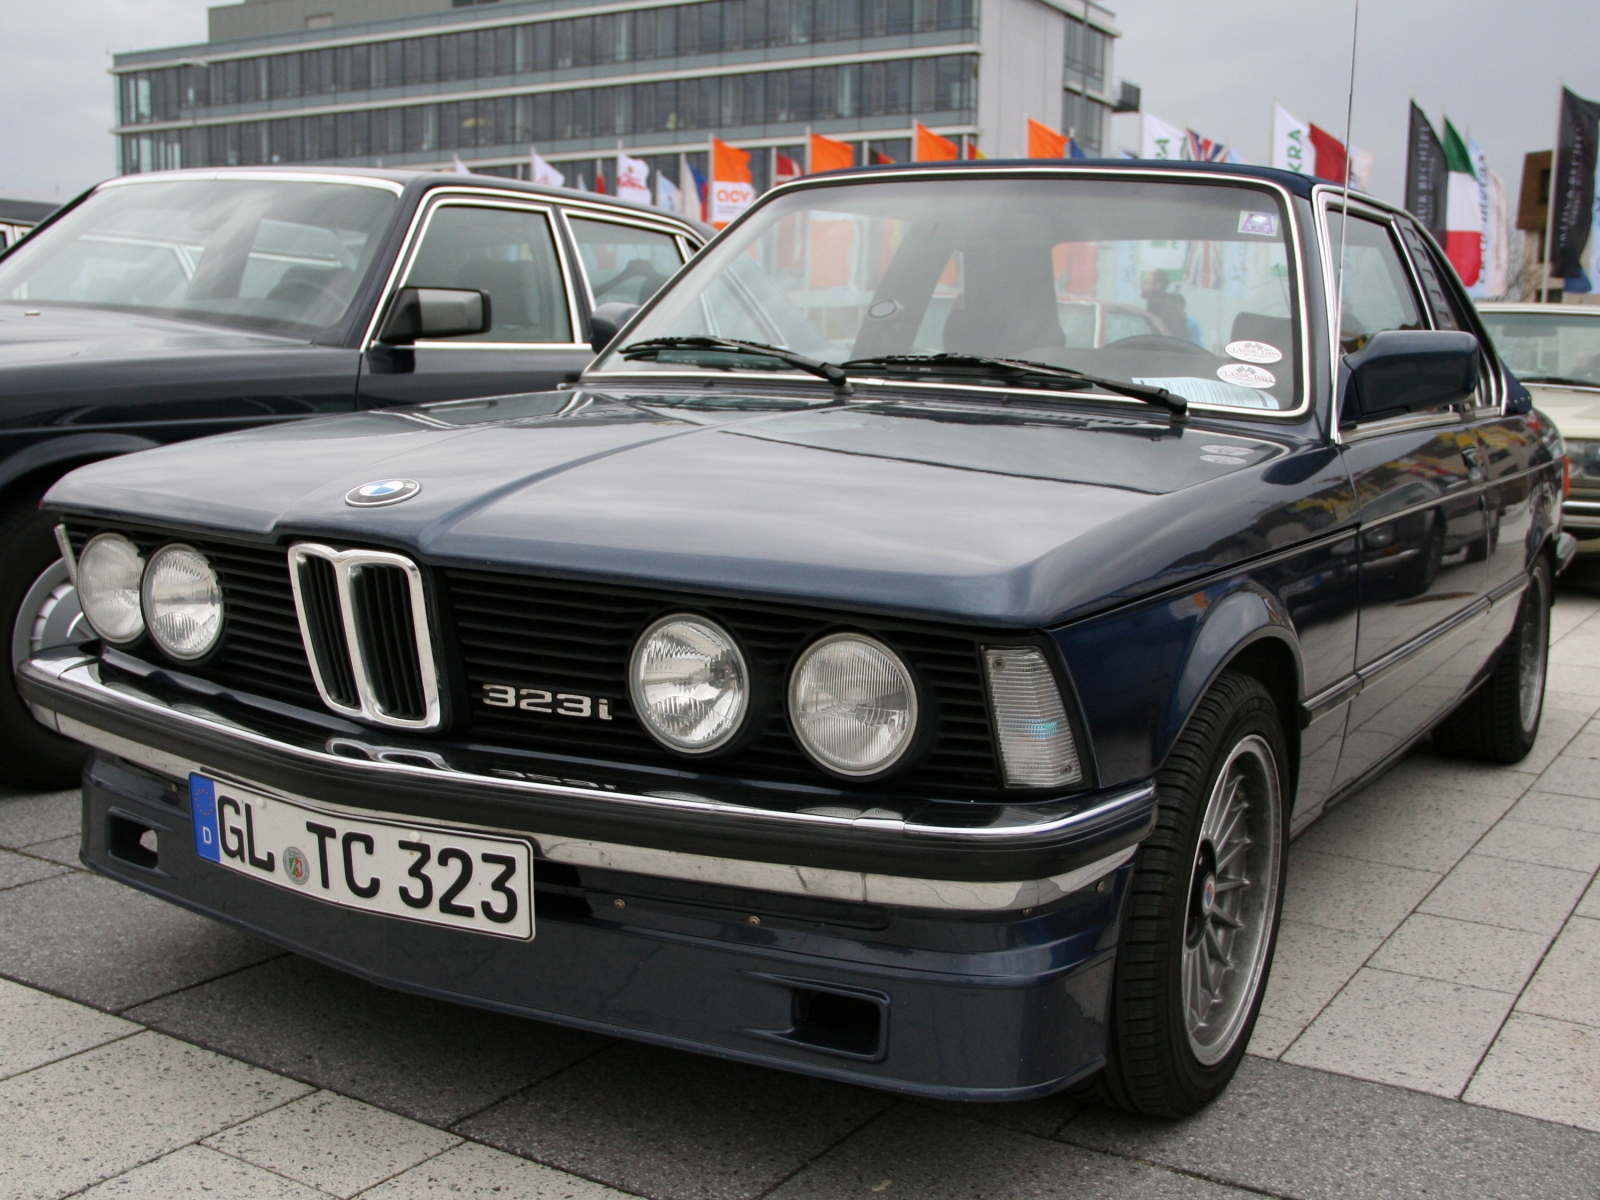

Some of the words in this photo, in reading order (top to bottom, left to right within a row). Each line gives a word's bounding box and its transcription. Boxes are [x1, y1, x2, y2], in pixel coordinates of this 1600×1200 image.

[1226, 346, 1258, 354] CLASSIC
[1261, 349, 1281, 358] DAYS
[1219, 370, 1252, 379] CLASSIC
[1253, 374, 1274, 383] DAYS
[482, 683, 613, 721] 323i
[202, 826, 212, 845] D
[217, 794, 276, 873] GL
[305, 820, 381, 899] TC
[398, 839, 518, 924] 323
